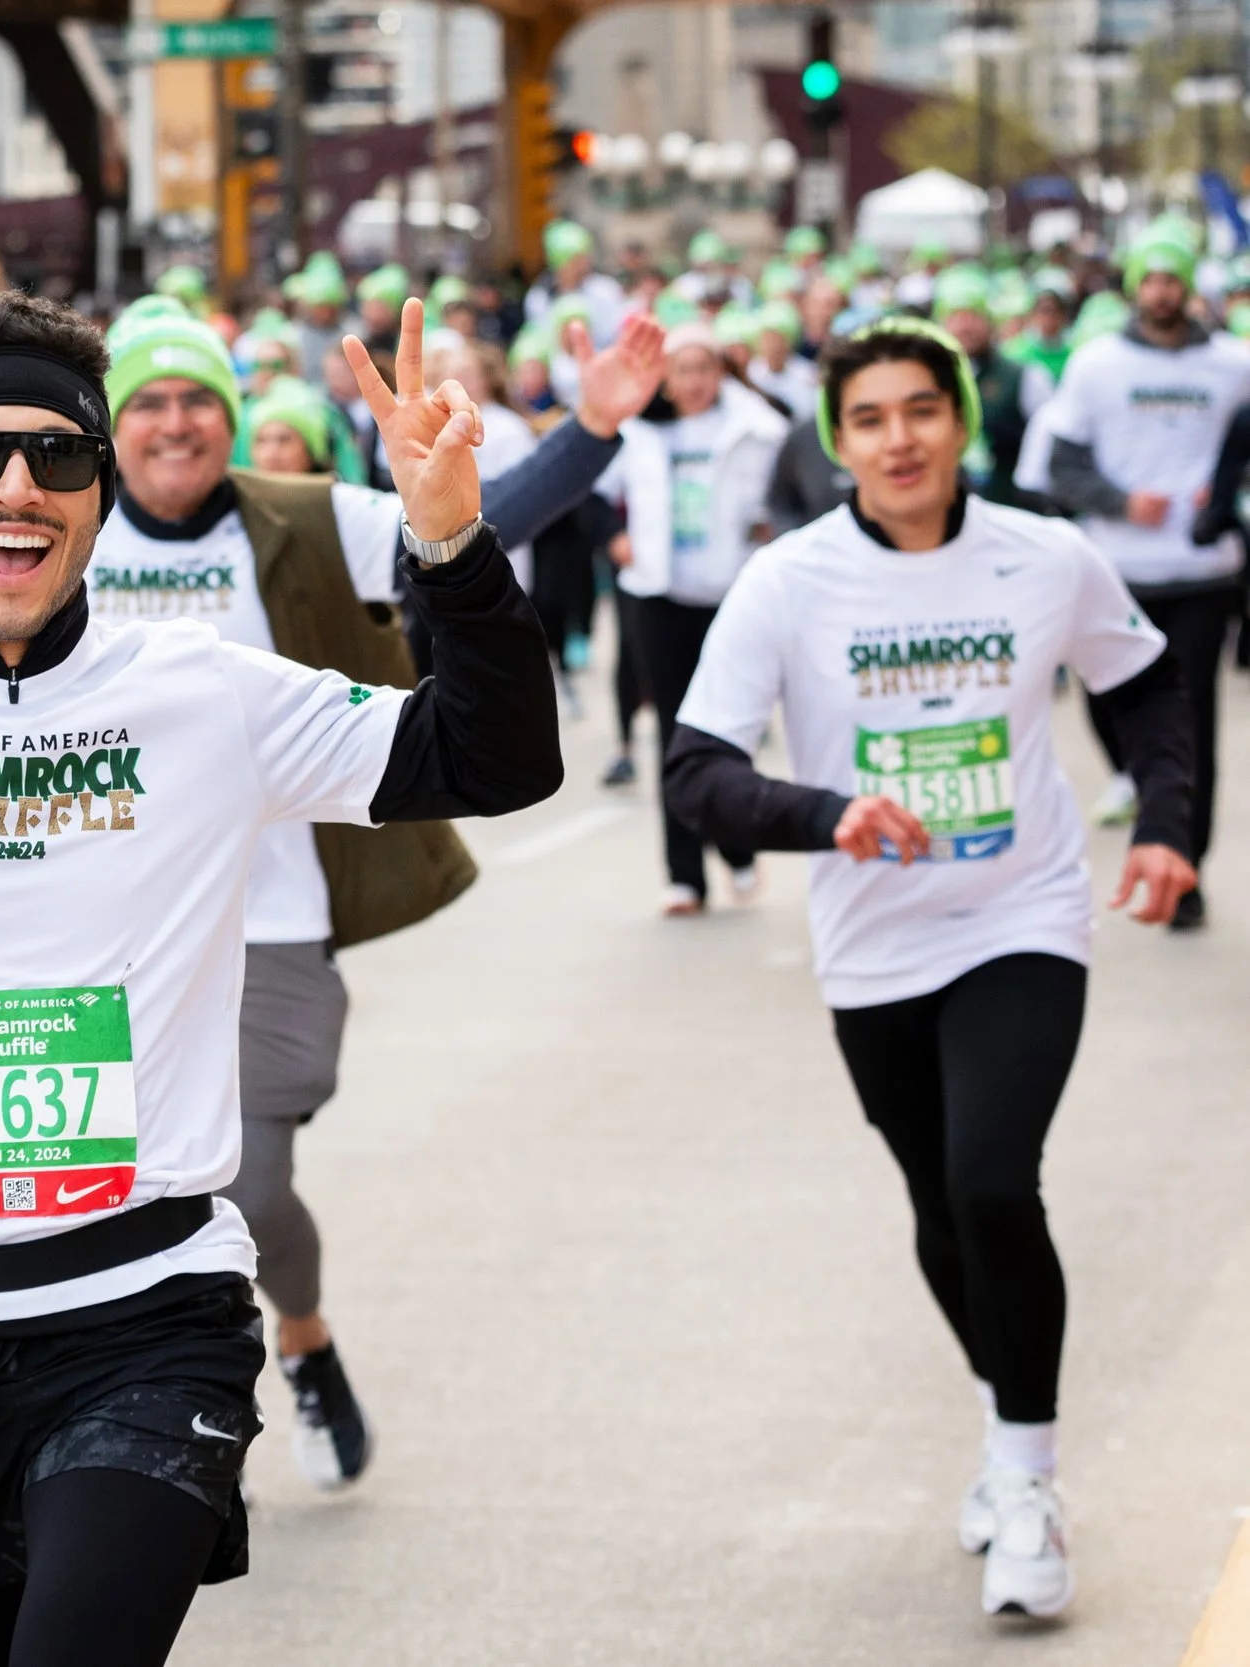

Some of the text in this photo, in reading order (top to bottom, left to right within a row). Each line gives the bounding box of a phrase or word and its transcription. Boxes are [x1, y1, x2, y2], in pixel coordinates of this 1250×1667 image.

[847, 632, 1015, 674] SHAMROCK
[21, 728, 130, 752] AMERICA
[4, 1000, 20, 1010] OF
[21, 998, 76, 1009] AMERICA
[6, 1148, 30, 1163] 24,
[34, 1147, 72, 1161] 2024
[107, 1195, 121, 1206] 19
